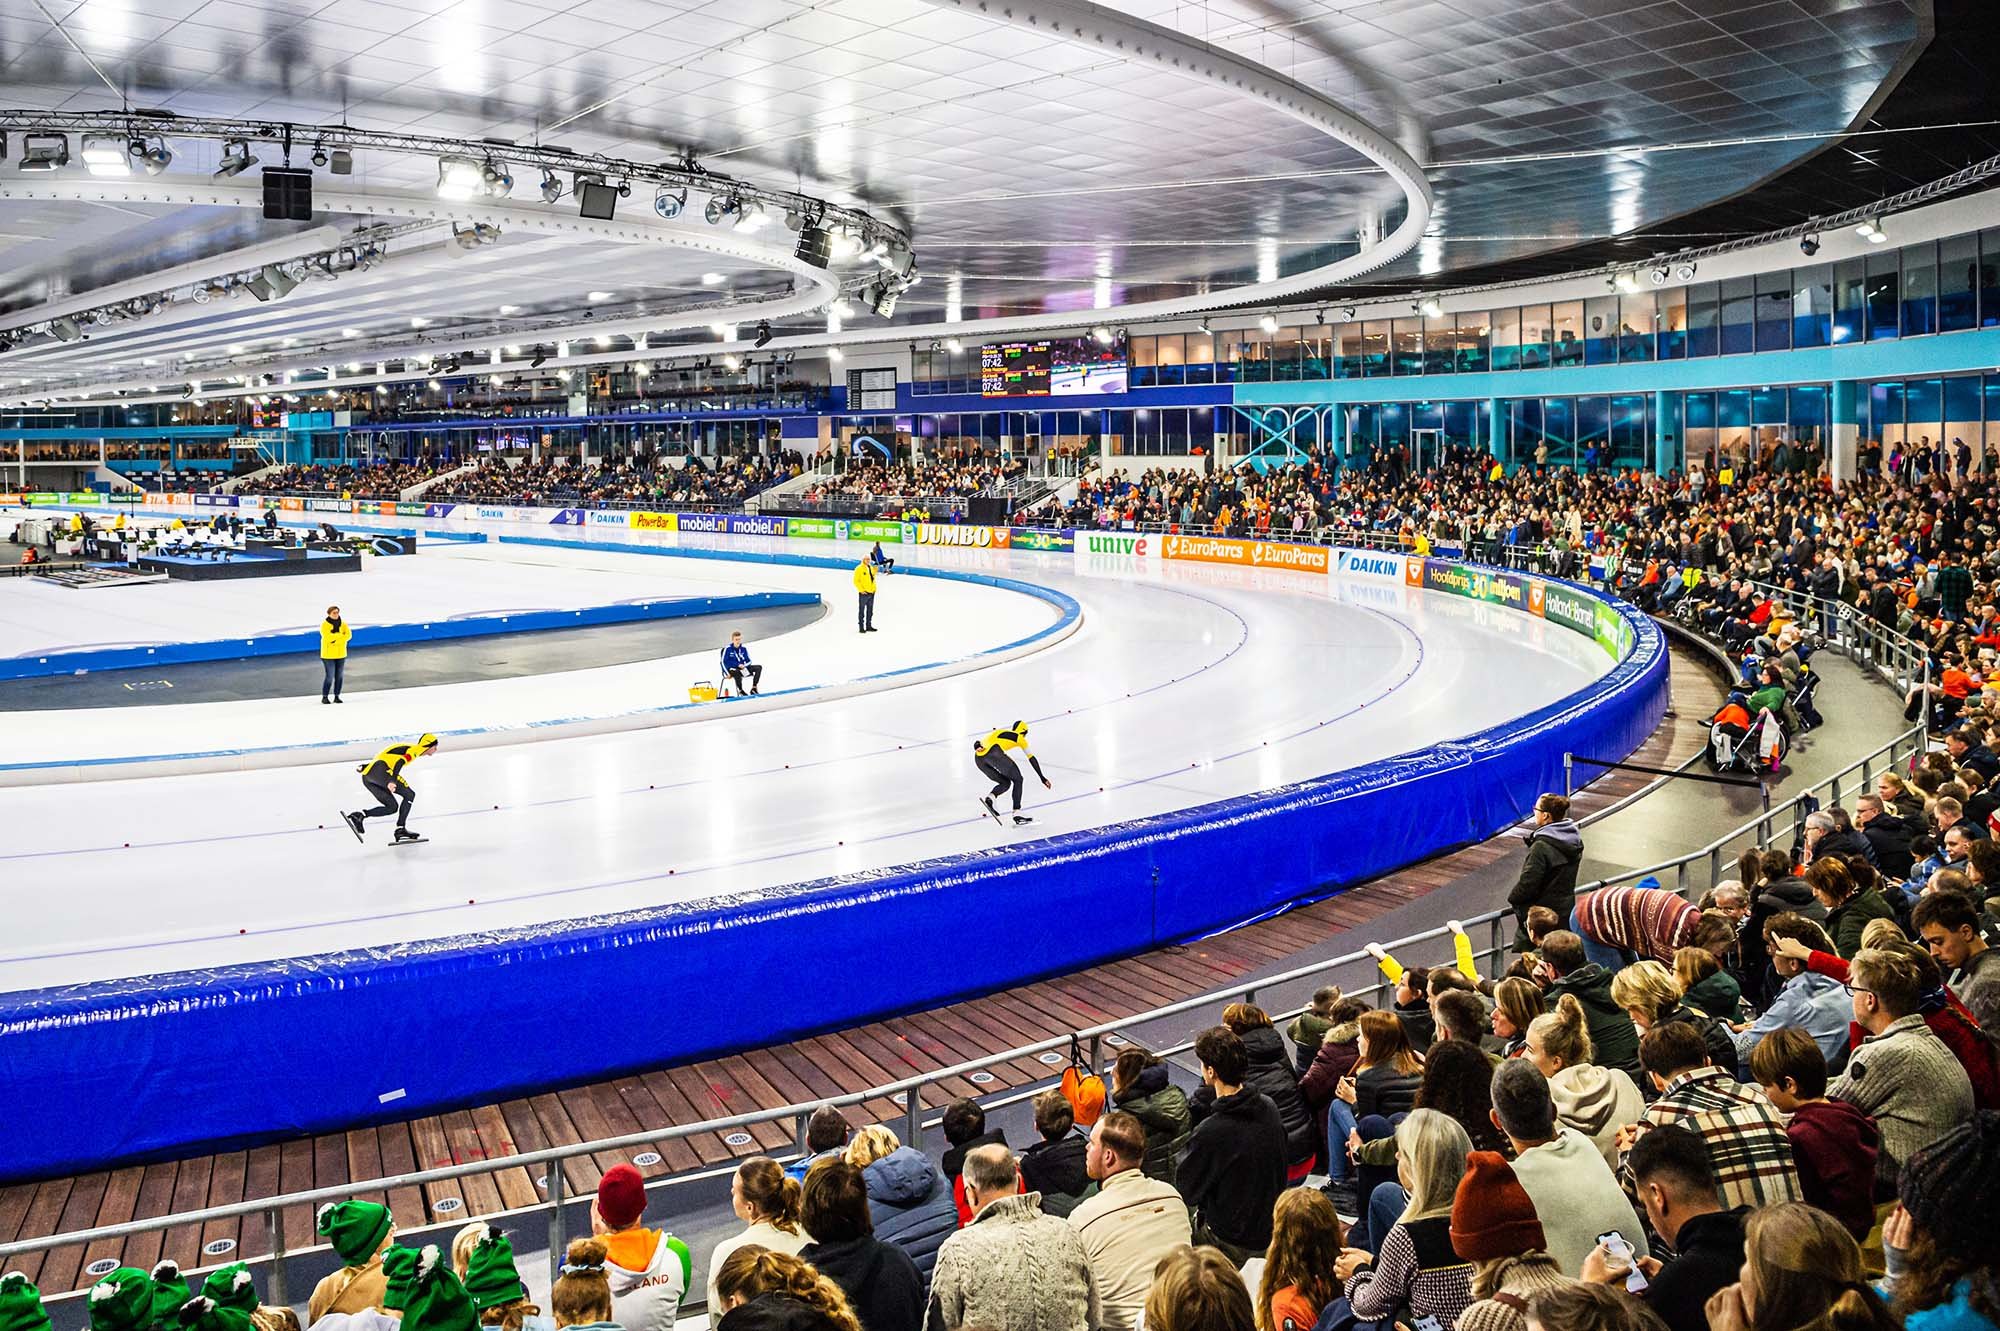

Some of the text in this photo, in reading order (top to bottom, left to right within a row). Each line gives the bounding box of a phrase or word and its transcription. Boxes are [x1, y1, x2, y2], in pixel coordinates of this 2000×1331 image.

[481, 510, 503, 518] DAIKIN
[597, 514, 625, 524] DAIKIN
[637, 514, 669, 528] PowerBar
[680, 517, 727, 532] mobiel.nl
[733, 519, 785, 535] mobiel.nl
[919, 525, 991, 547] JUMBO
[1033, 533, 1050, 548] 30
[1089, 533, 1148, 556] univé
[1180, 539, 1244, 558] EuroParcs
[1264, 545, 1325, 567] EuroParcs
[1350, 557, 1397, 576] DAIKIN
[1430, 567, 1521, 601] Hoofdprijs 30 miljoen
